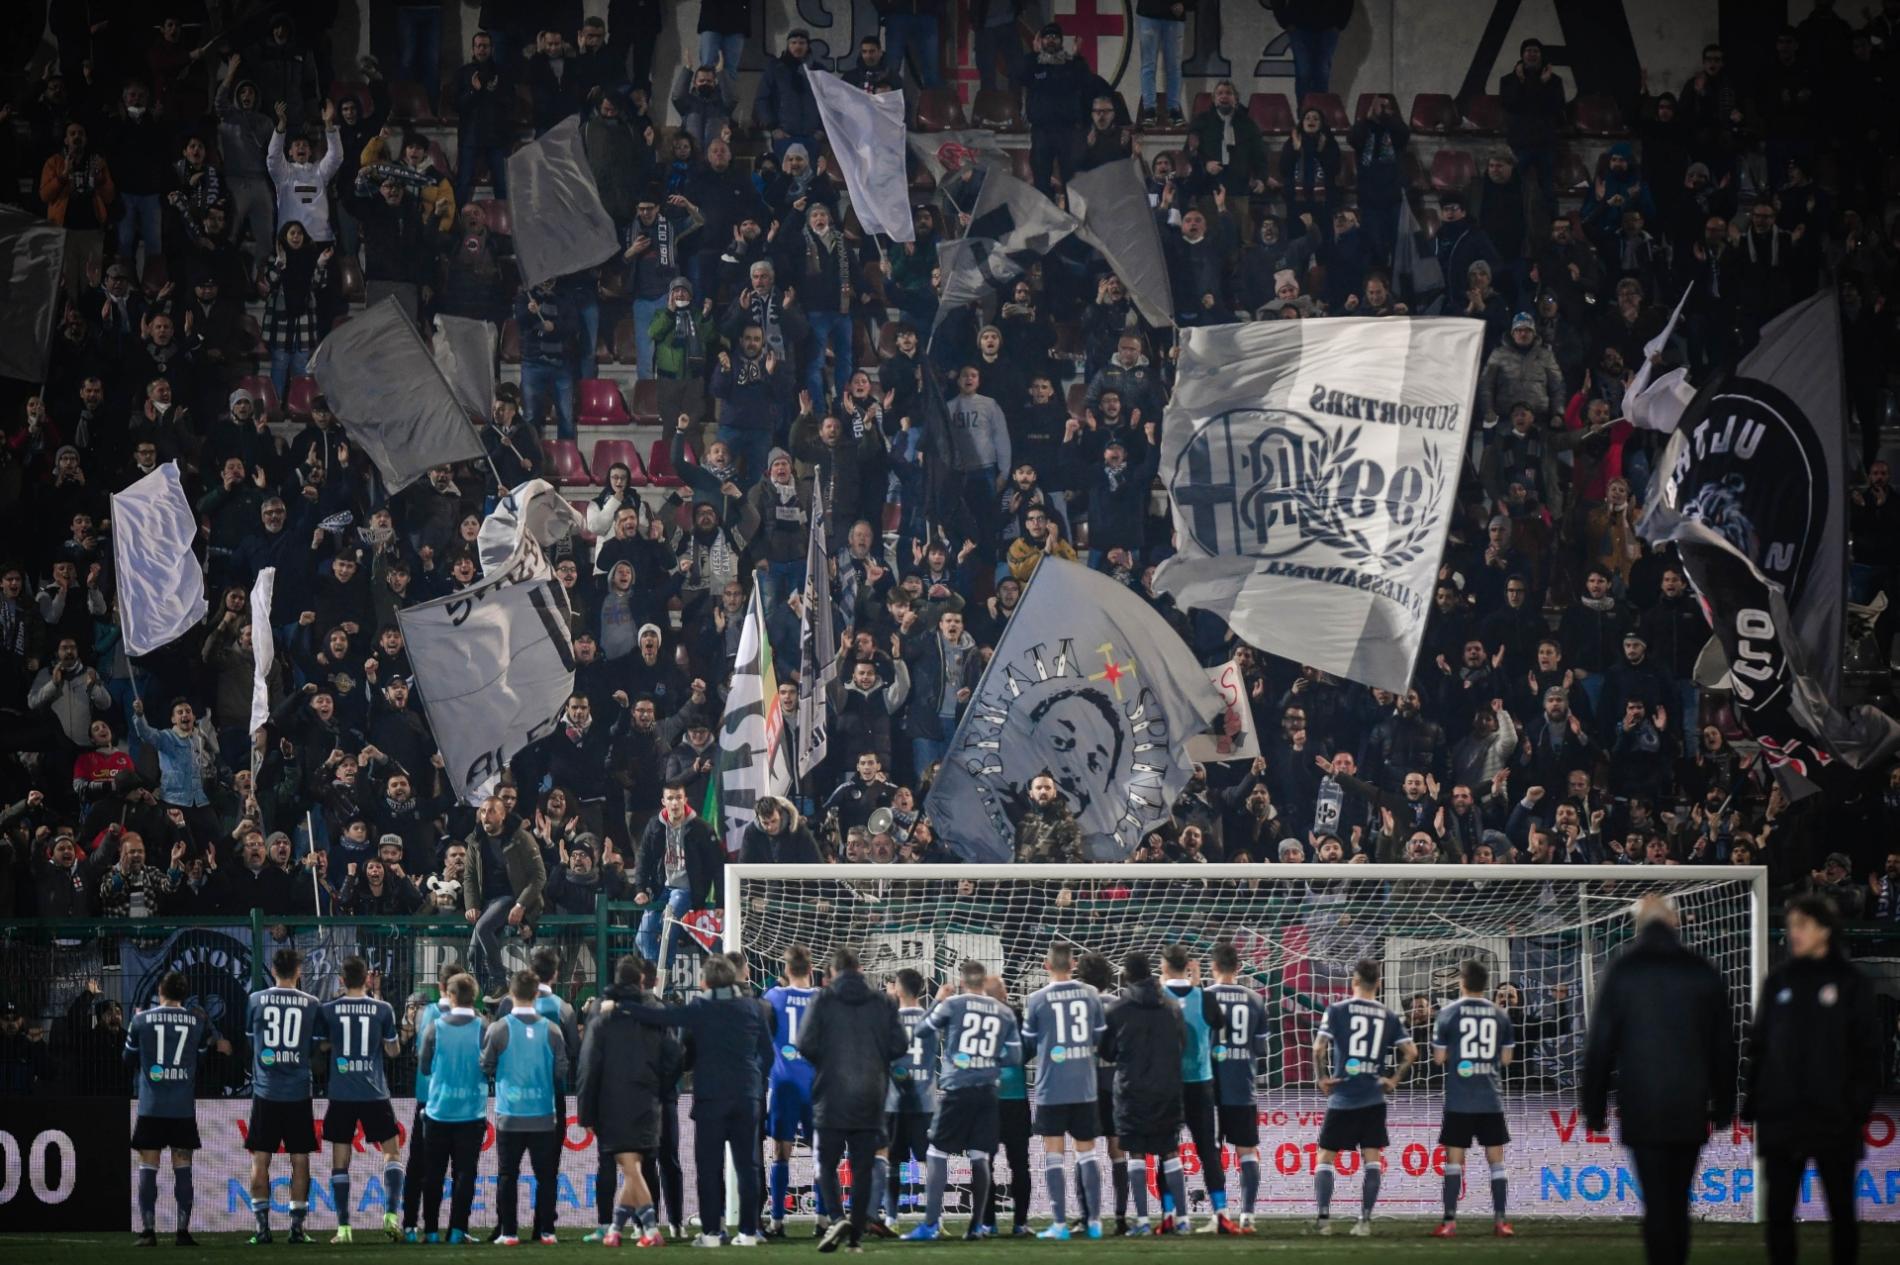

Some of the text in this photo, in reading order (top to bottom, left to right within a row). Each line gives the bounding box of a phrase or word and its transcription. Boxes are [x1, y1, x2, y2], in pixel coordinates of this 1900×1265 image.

[964, 637, 1084, 777] BRIGATA
[264, 1006, 303, 1049] 30
[334, 1003, 377, 1016] MATTIELLO
[1051, 1000, 1089, 1045] 13
[1216, 1005, 1250, 1046] 19
[153, 1024, 189, 1066] 17
[339, 1016, 370, 1057] 11
[960, 1012, 1001, 1058] 23
[1349, 1016, 1384, 1060] 21
[1459, 1017, 1498, 1060] 29
[1541, 1165, 1647, 1202] NON
